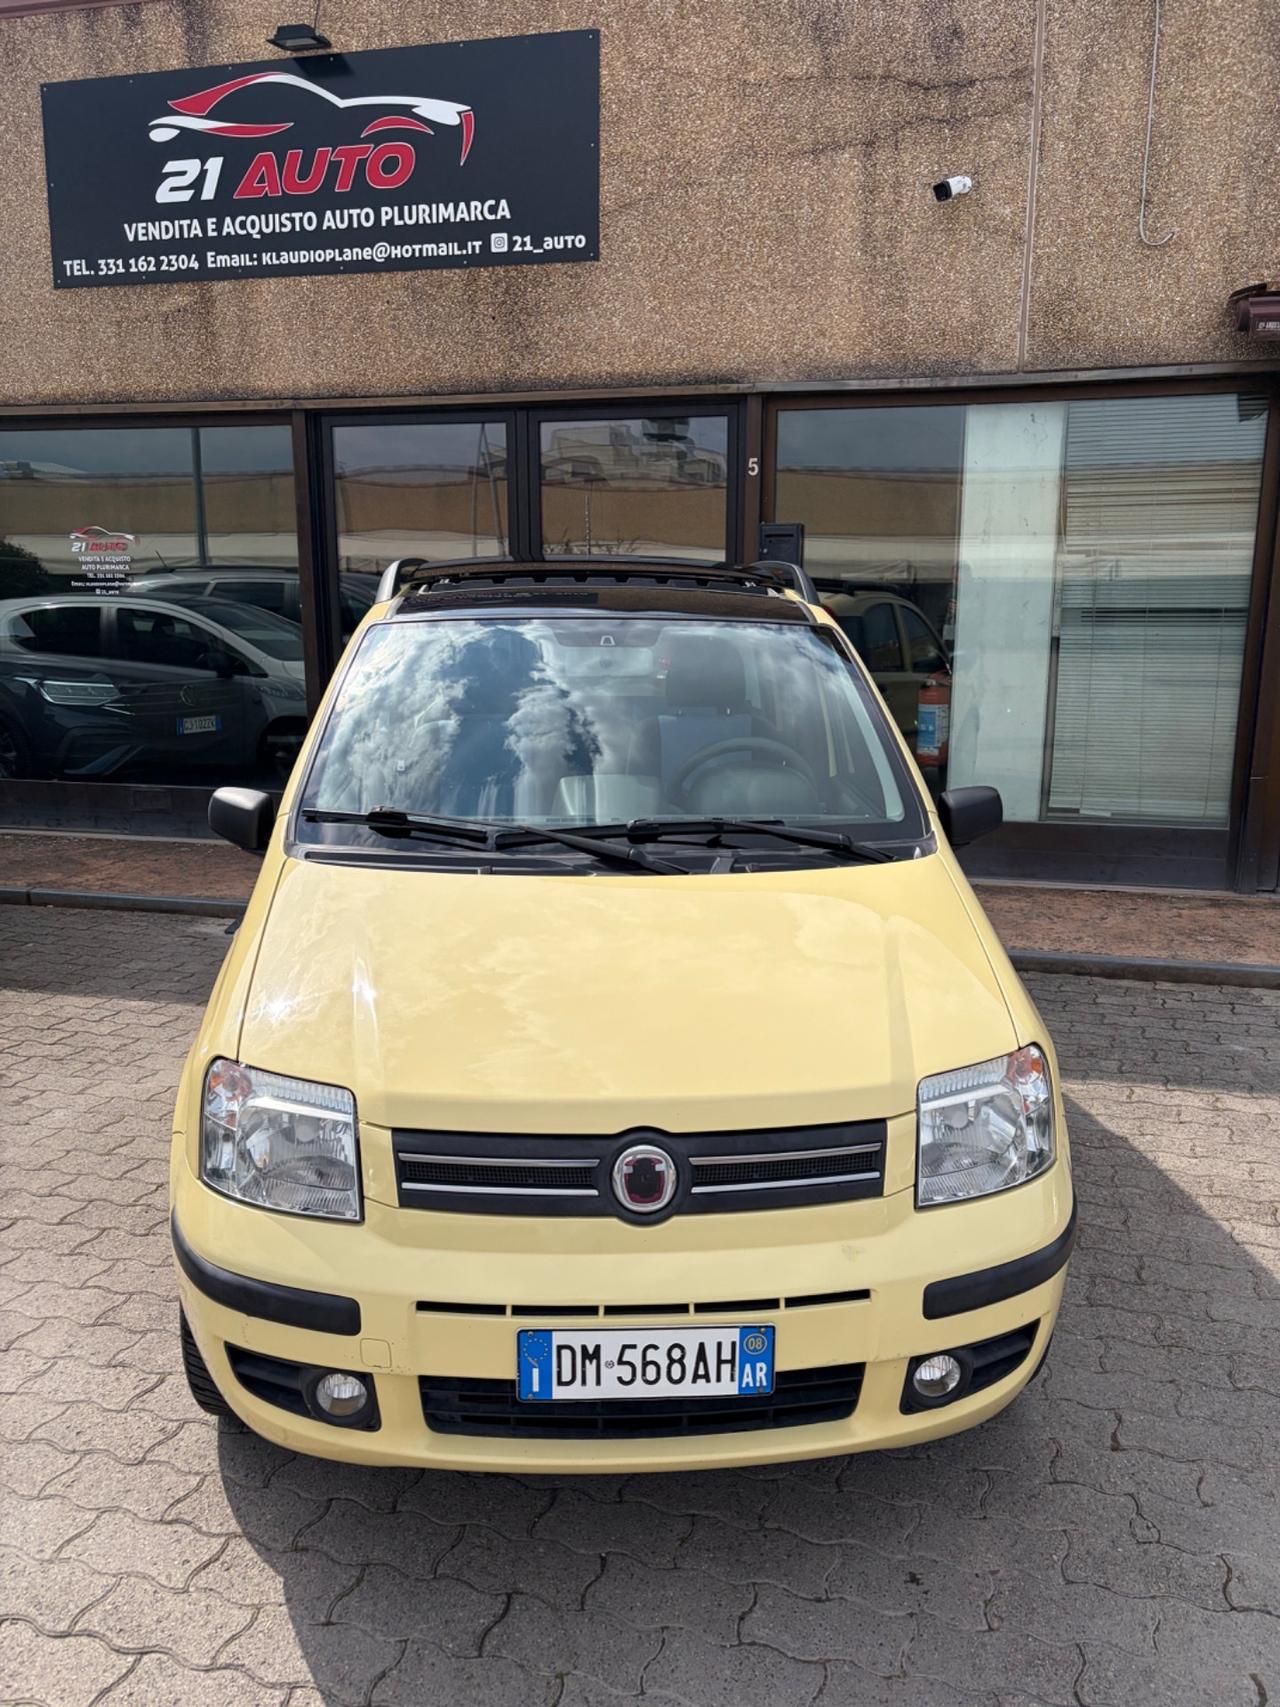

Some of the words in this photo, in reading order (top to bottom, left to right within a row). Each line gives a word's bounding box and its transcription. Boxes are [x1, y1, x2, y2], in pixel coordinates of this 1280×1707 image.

[155, 156, 224, 204] 21
[232, 141, 416, 199] AUTO
[123, 218, 203, 242] VENDITA
[206, 217, 218, 237] E
[222, 211, 317, 239] ACQUISTO
[322, 207, 375, 230] AUTO
[380, 199, 511, 227] PLURIMARCA
[63, 259, 95, 277] TEL.
[98, 258, 125, 276] 331
[128, 255, 157, 273] 162
[159, 253, 199, 272] 2304
[748, 457, 759, 476] 5
[71, 542, 86, 552] 21
[88, 542, 128, 552] AUTO
[748, 1337, 763, 1350] 08
[741, 1362, 768, 1388] AR
